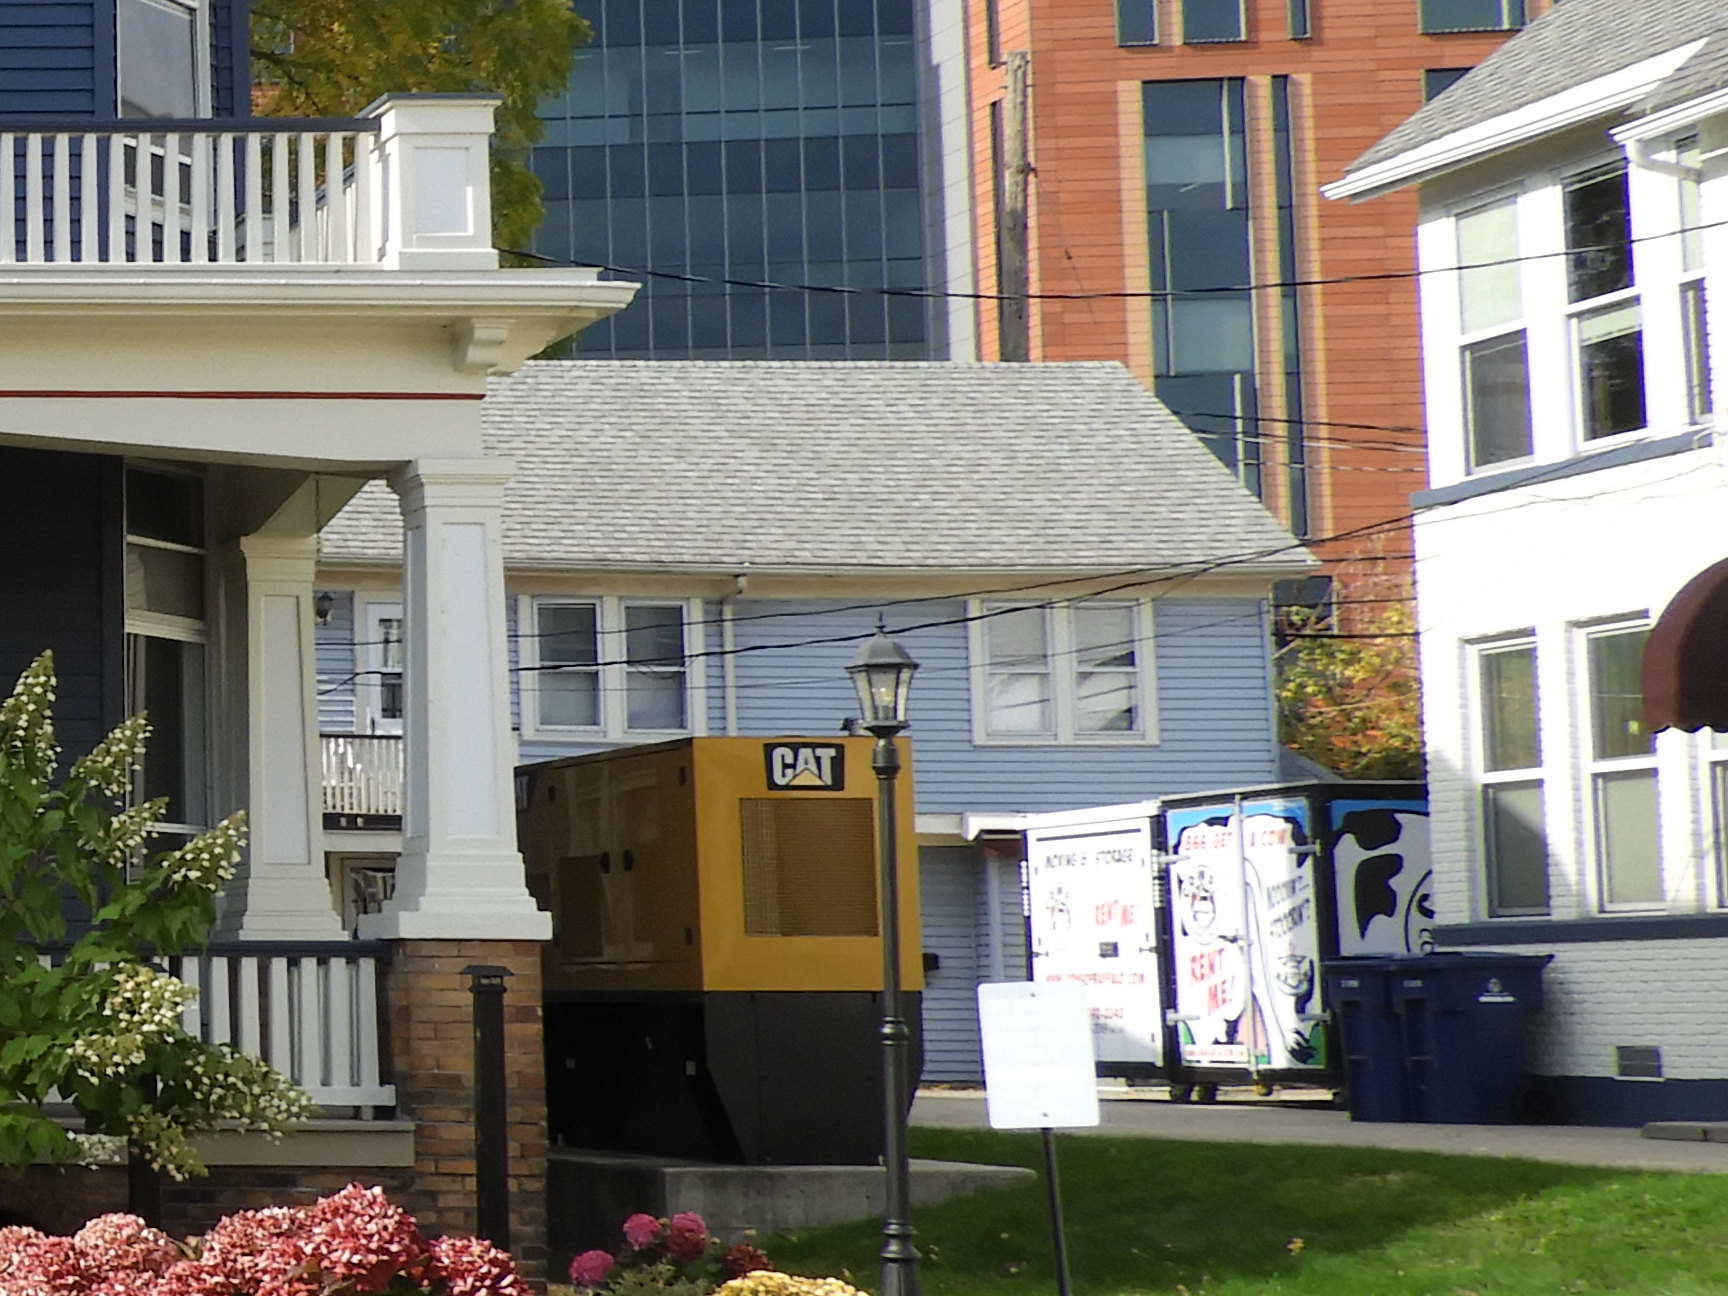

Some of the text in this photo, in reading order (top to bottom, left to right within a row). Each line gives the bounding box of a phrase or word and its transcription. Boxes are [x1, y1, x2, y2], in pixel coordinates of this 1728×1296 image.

[772, 746, 837, 786] CAT
[1190, 948, 1225, 983] RENT
[1208, 975, 1236, 1015] ME!
